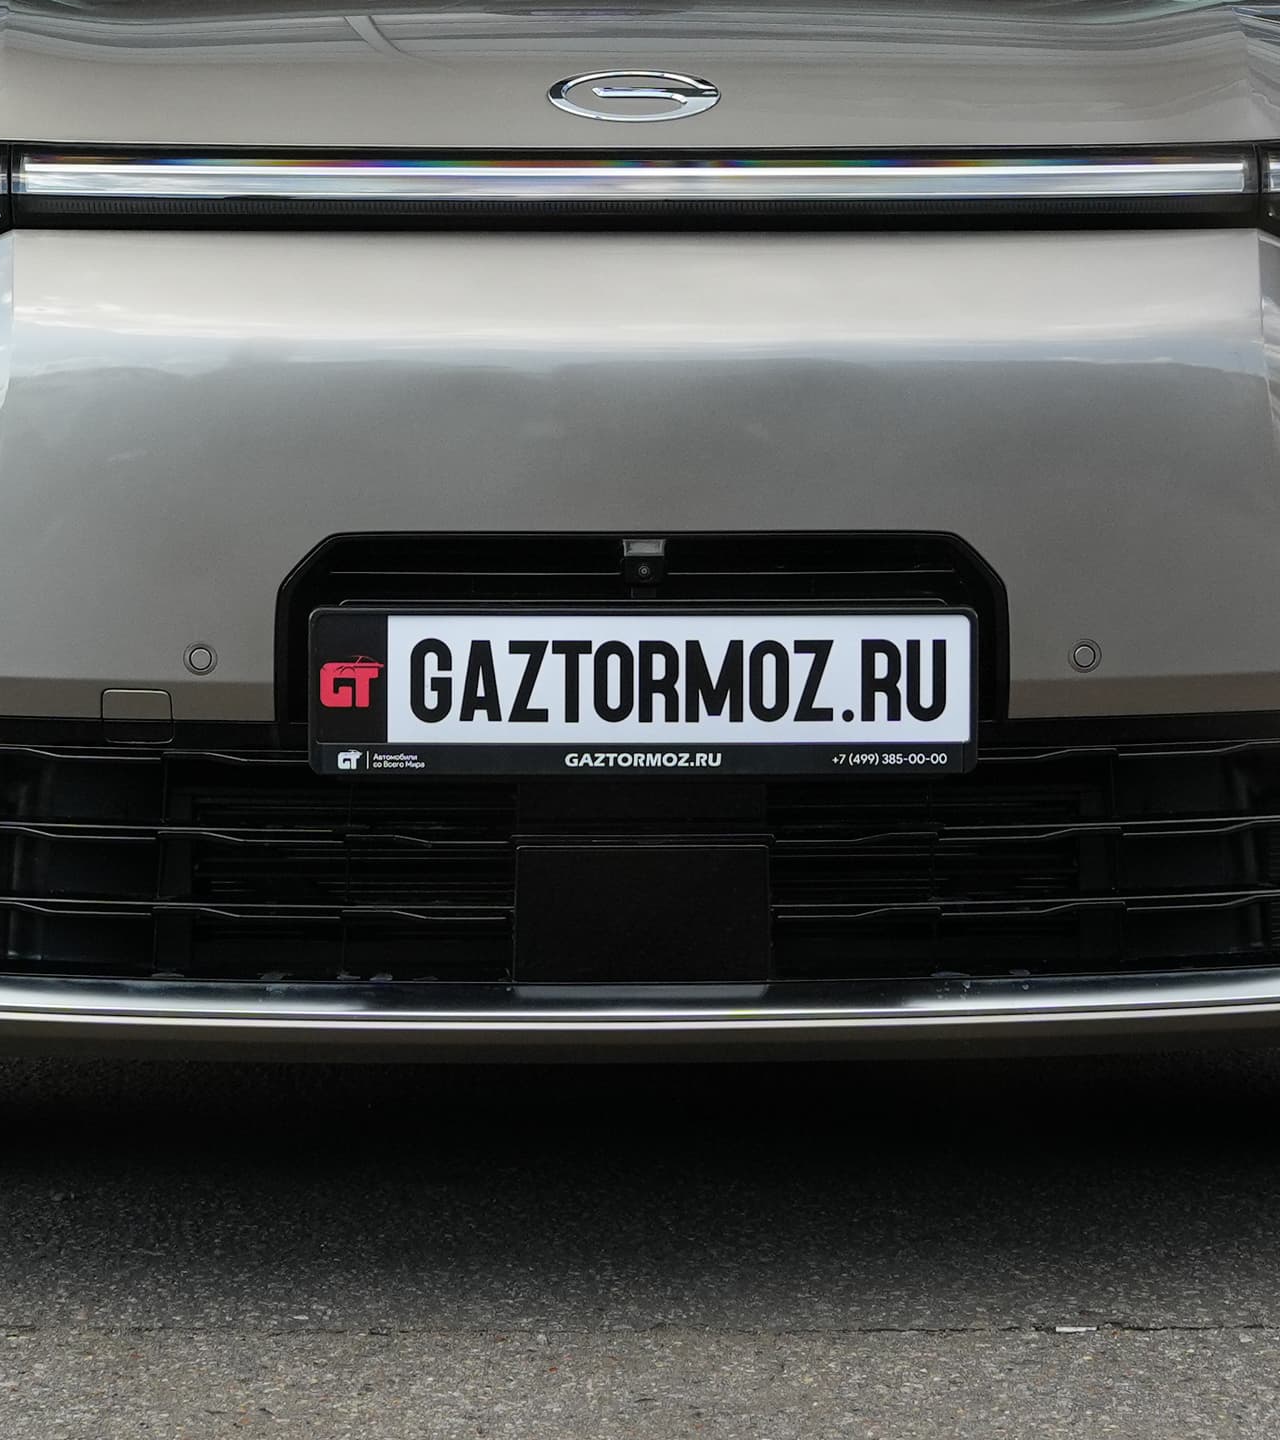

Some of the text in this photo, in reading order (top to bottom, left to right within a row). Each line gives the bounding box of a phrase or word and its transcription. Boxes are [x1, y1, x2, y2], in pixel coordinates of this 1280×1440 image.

[319, 659, 383, 708] GT
[410, 637, 947, 724] GAZTORMOZ.RU
[337, 749, 362, 769] GT
[564, 752, 722, 768] GAZTORMOZ.RU
[831, 752, 948, 766] +7 (499) 385-00-00
